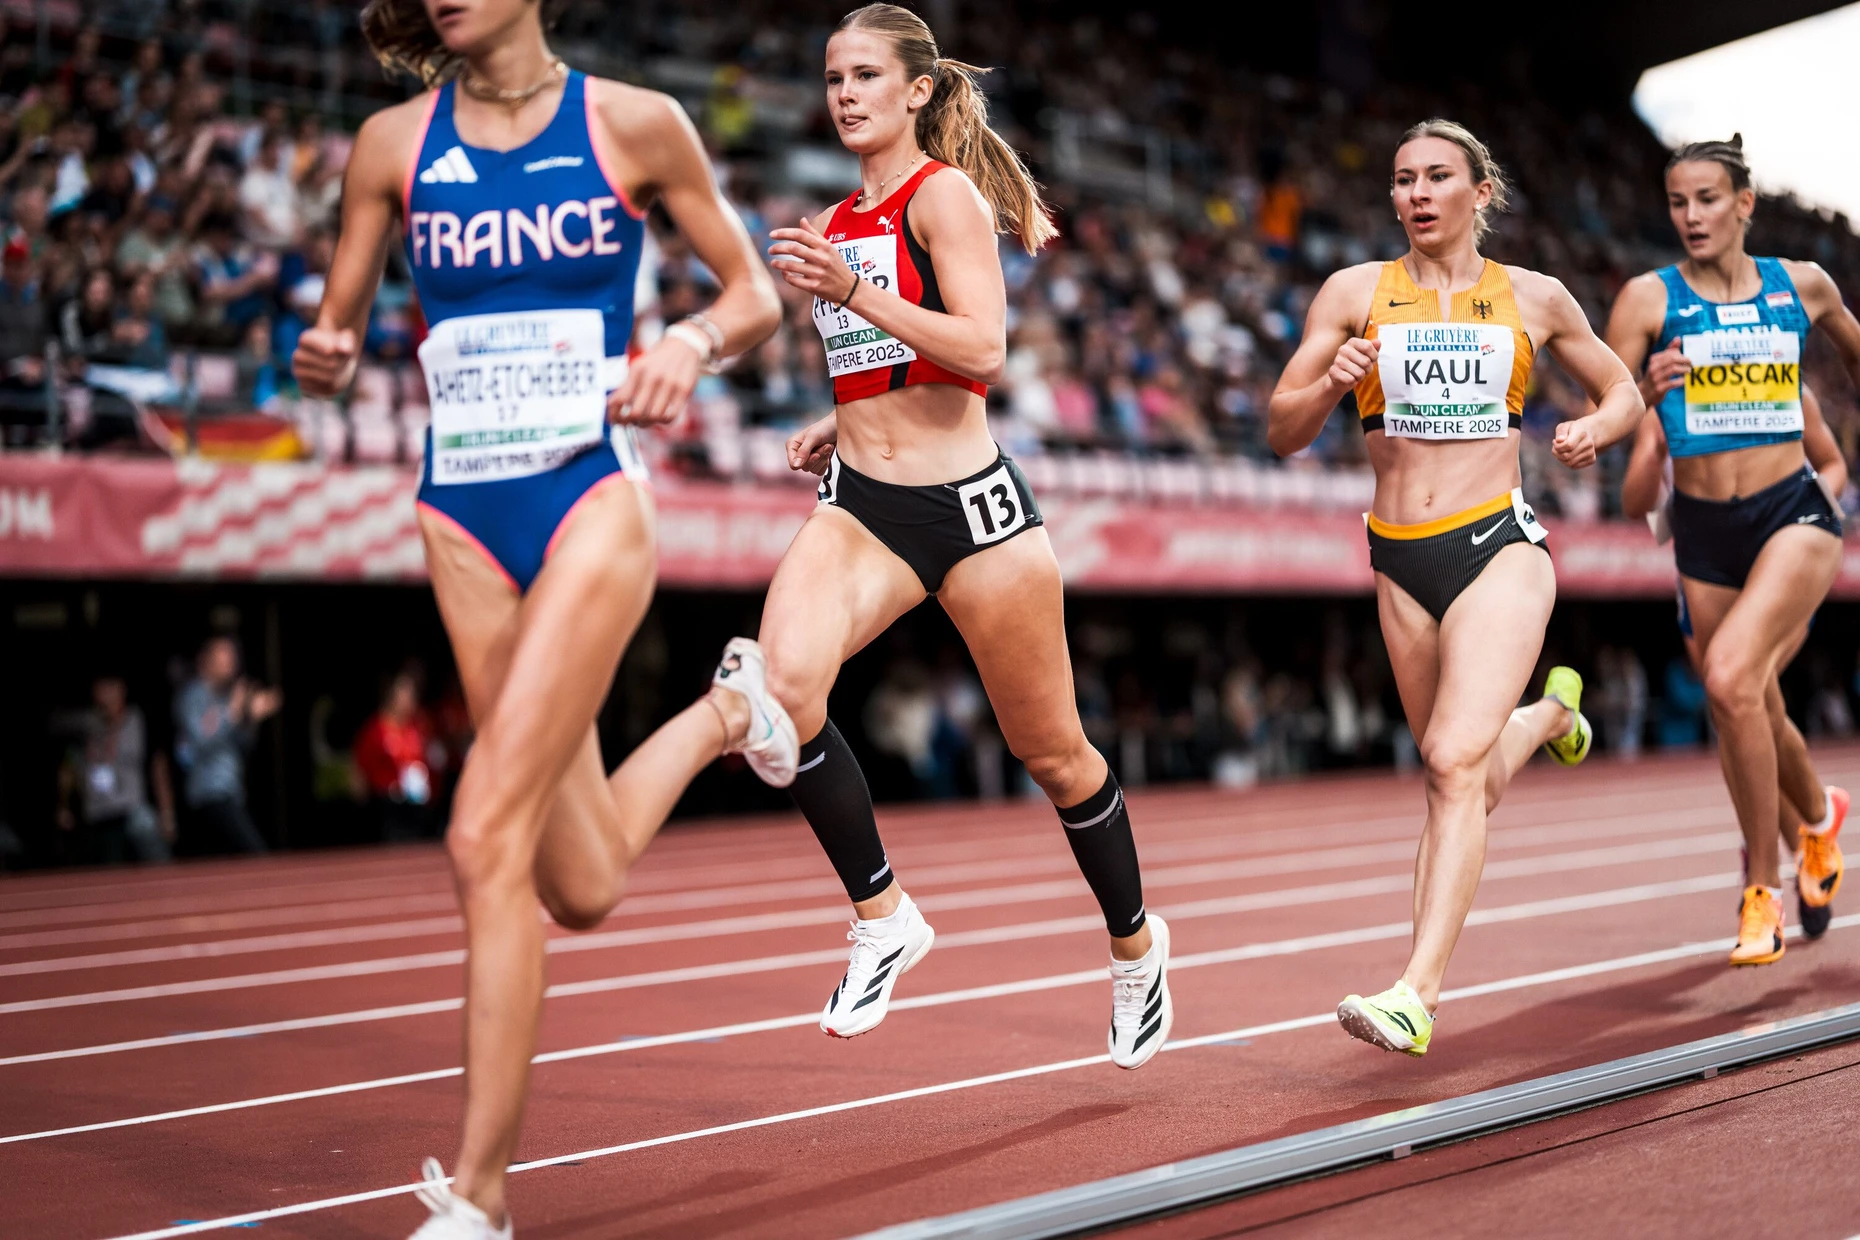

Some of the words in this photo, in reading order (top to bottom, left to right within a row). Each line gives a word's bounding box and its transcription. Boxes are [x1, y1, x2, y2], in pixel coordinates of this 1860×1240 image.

[411, 196, 622, 269] FRANCE
[836, 314, 849, 330] 13
[843, 330, 876, 346] CLEAN
[1407, 329, 1421, 344] LE
[1424, 327, 1479, 343] GRUYÈRE
[865, 343, 905, 364] 2025
[1408, 344, 1478, 352] SWITZERLAND
[1404, 359, 1487, 385] KAUL
[1441, 387, 1450, 400] 4
[1441, 404, 1480, 416] CLEAN
[1390, 419, 1465, 434] TAMPERE
[1469, 419, 1502, 433] 2025
[1695, 415, 1760, 429] TAMPERE
[969, 483, 1016, 537] 13
